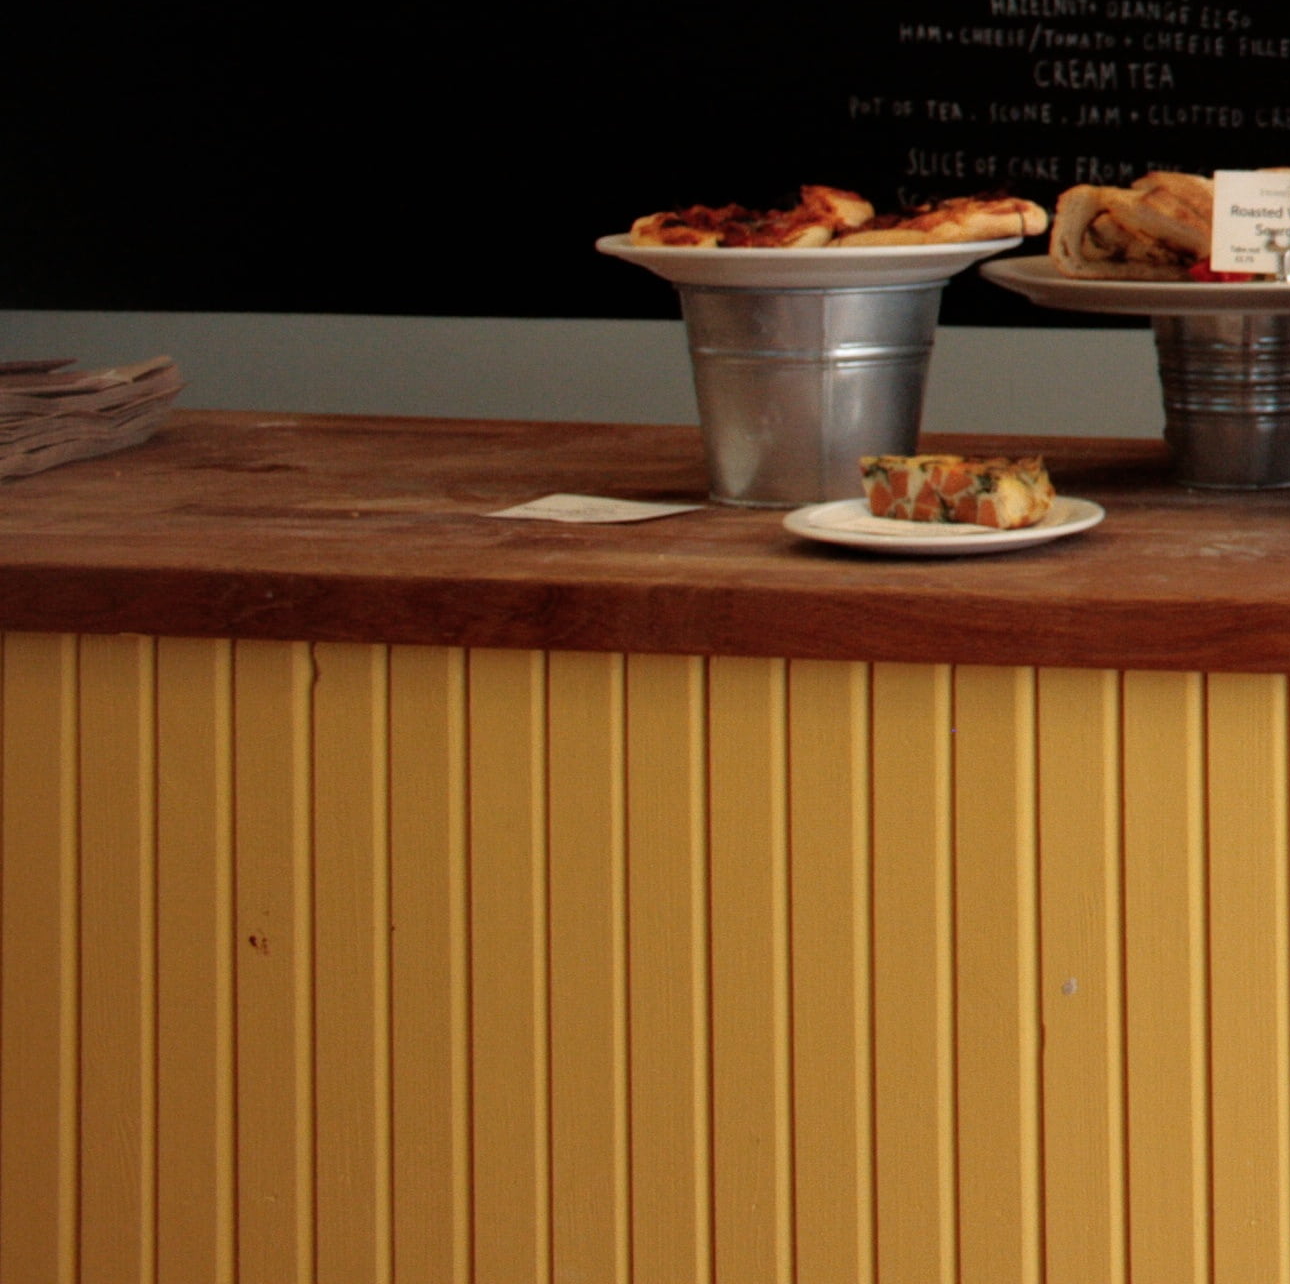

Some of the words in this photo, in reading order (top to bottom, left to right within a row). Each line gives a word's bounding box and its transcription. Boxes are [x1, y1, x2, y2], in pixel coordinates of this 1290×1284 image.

[1032, 57, 1120, 92] CREAM
[1127, 59, 1176, 92] TEA
[848, 93, 885, 119] POT
[1075, 100, 1123, 130] JAM
[1147, 103, 1244, 130] CLOTTED
[905, 146, 967, 180] SLICE
[974, 155, 998, 180] OF
[1007, 155, 1062, 183] CAKE
[1230, 204, 1283, 219] Roasted
